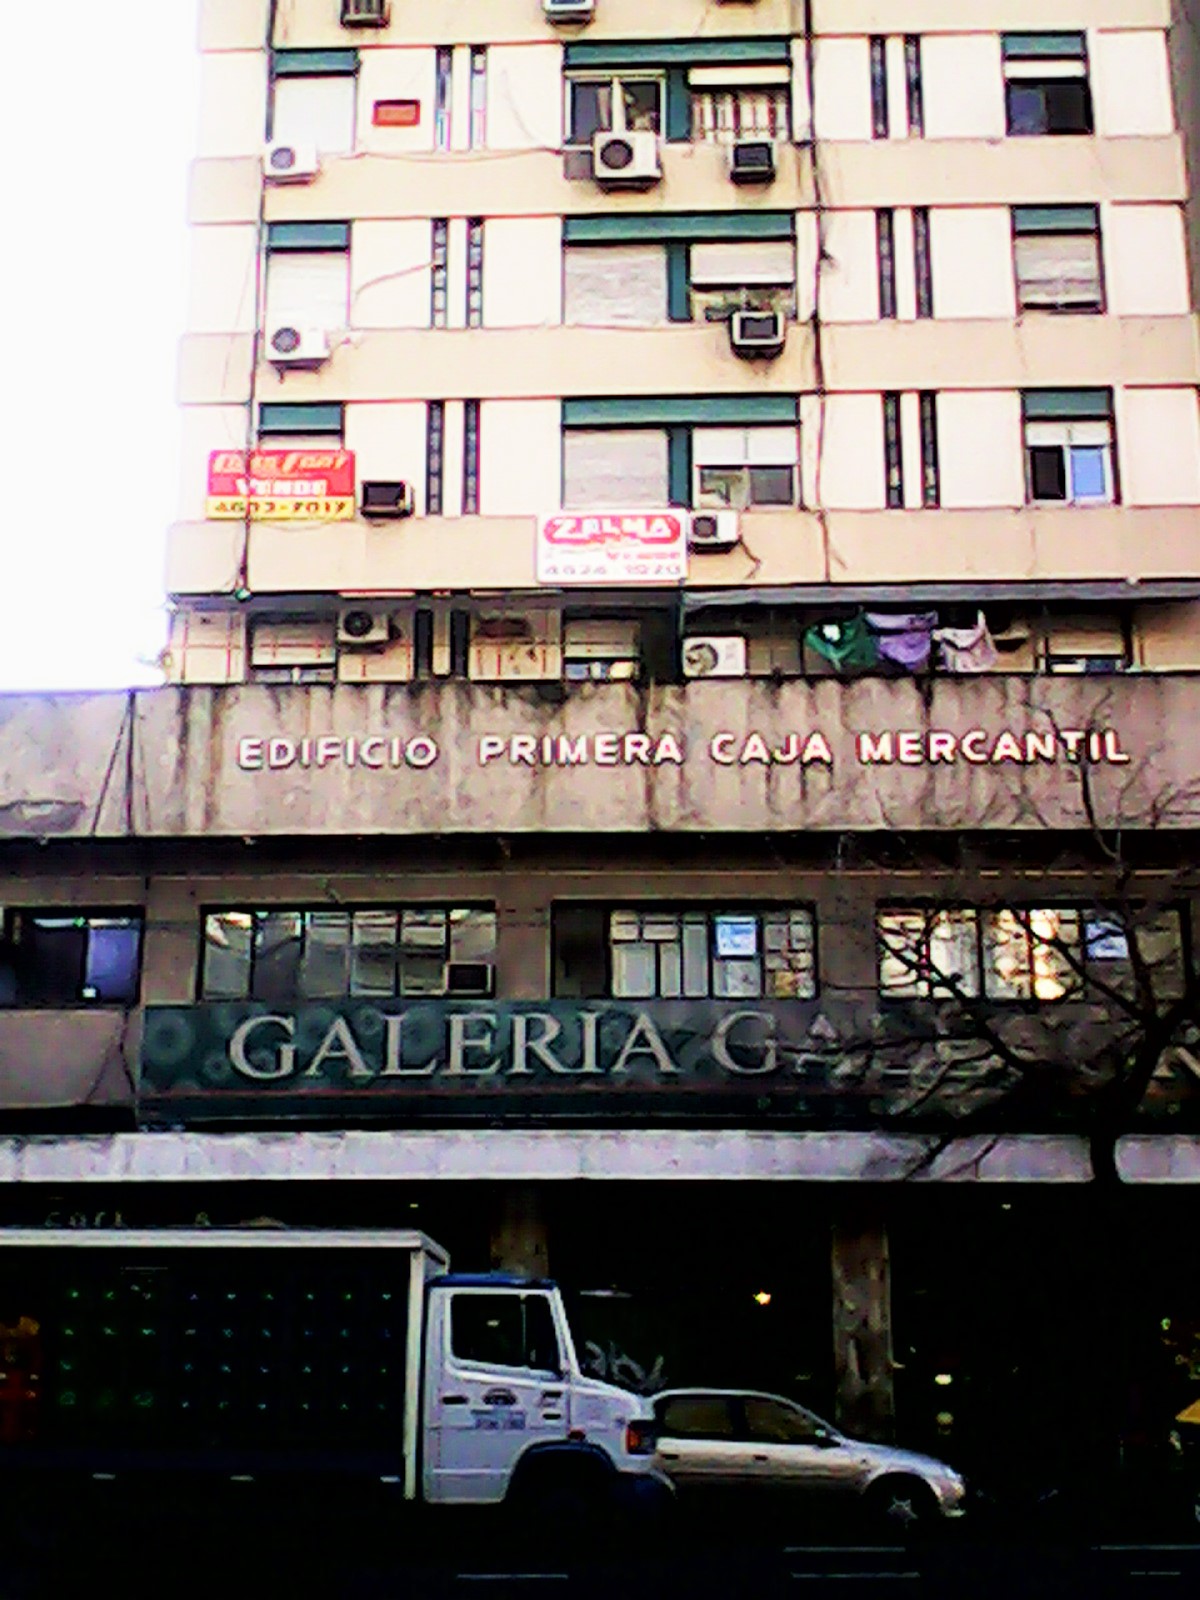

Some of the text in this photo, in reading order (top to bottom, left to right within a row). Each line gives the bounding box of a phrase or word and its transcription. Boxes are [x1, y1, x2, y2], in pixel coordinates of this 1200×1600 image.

[236, 479, 327, 495] VENDE
[238, 731, 1130, 769] EDIFICIO PRIMERA CAJA MERCANTIL
[229, 1011, 678, 1079] GALERIA
